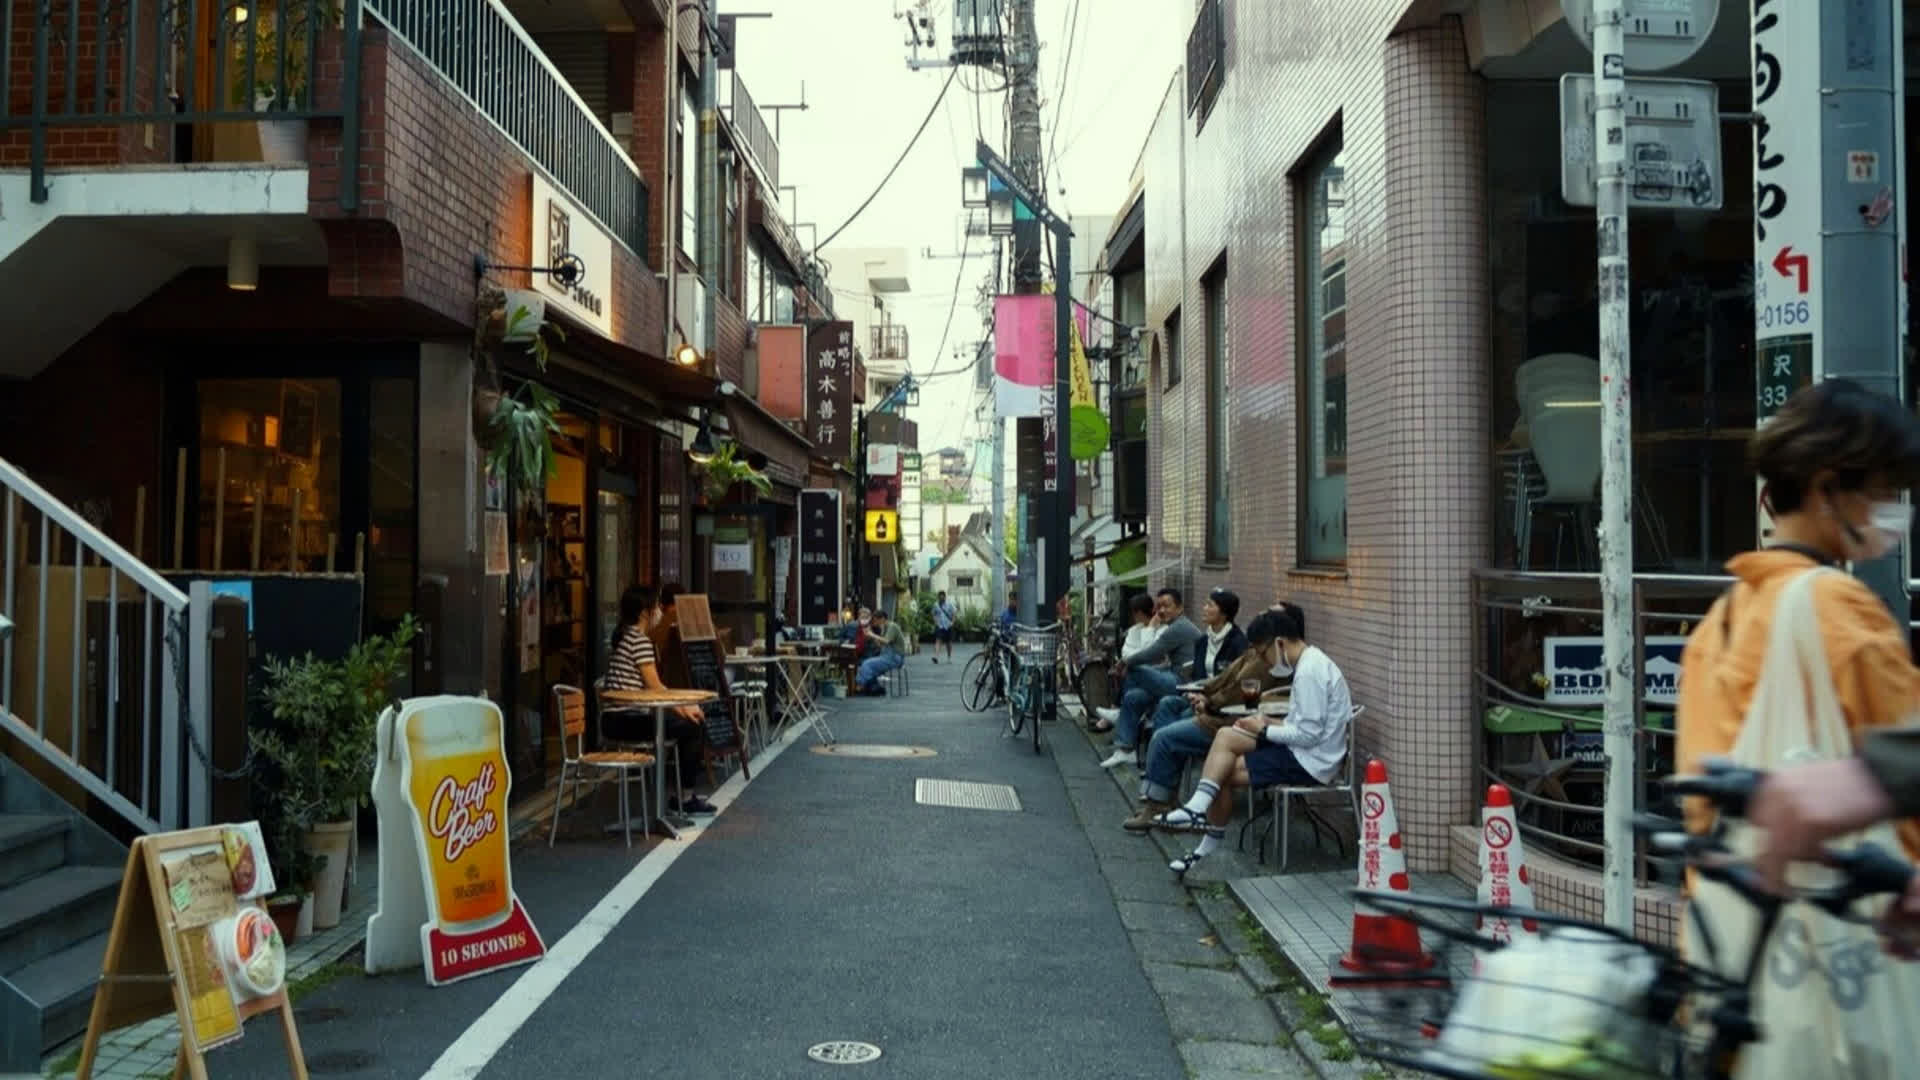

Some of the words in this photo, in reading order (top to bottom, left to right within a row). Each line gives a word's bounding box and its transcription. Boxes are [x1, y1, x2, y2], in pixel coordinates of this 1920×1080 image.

[429, 762, 496, 836] Craft
[446, 807, 497, 861] Beer
[440, 949, 458, 967] 10
[461, 931, 527, 961] SECONDS
